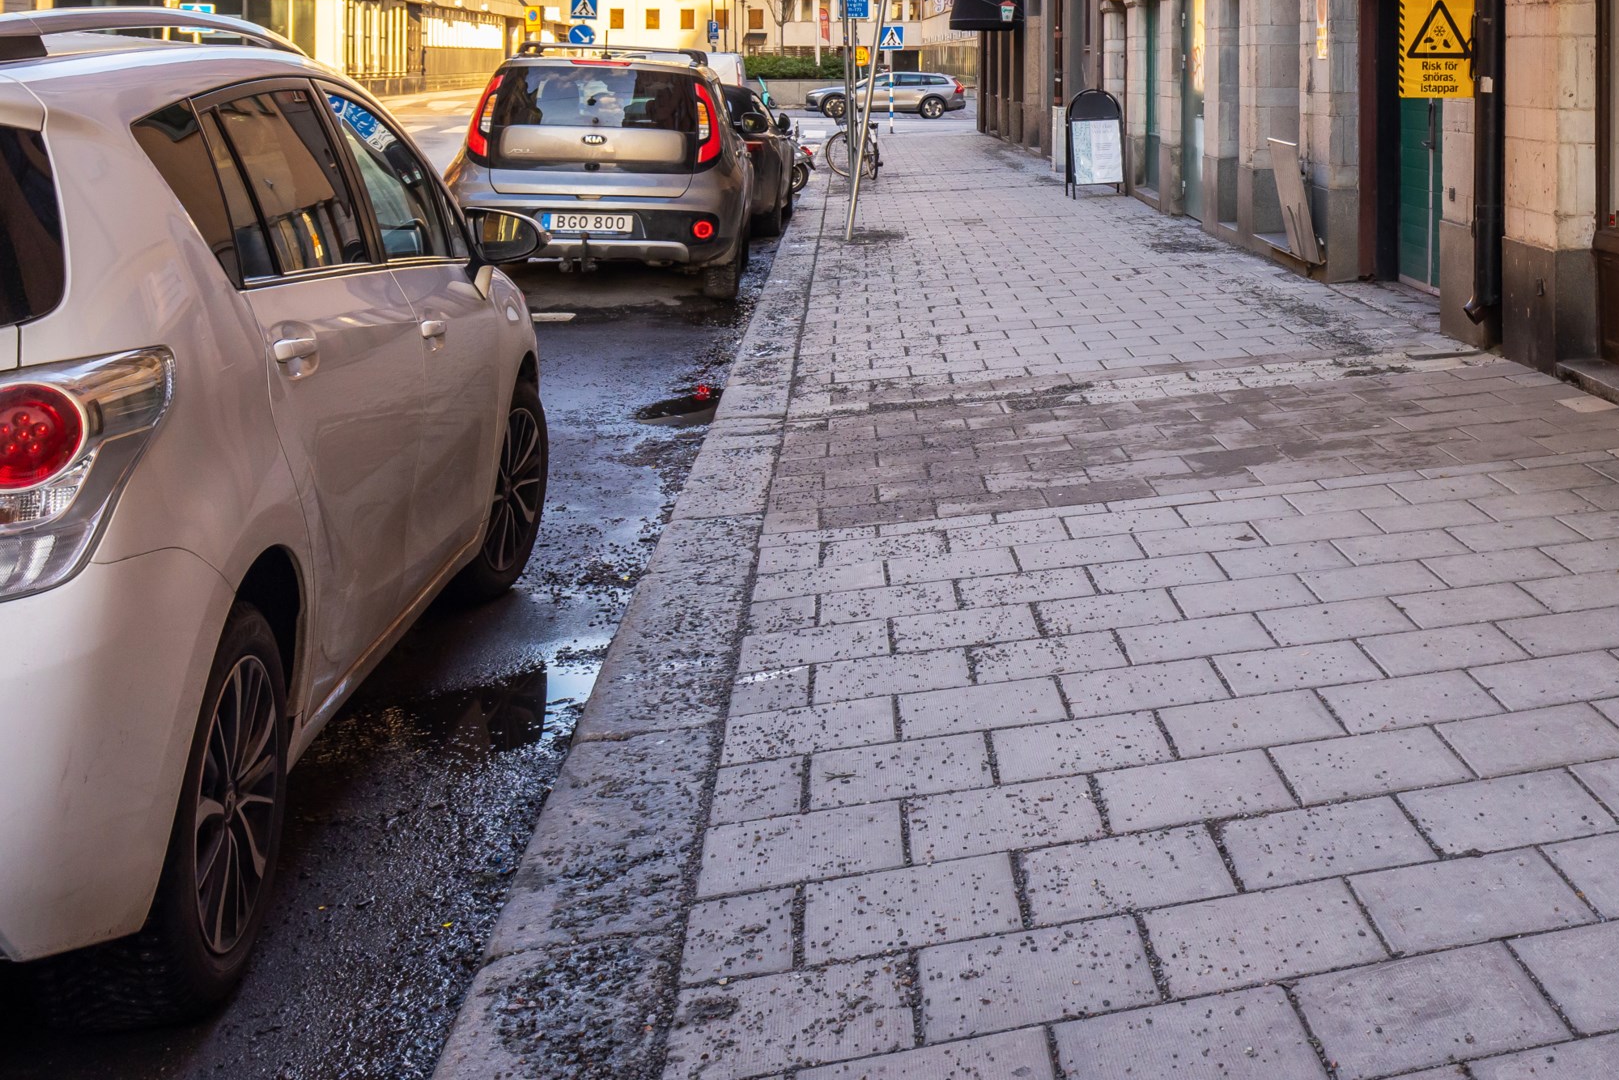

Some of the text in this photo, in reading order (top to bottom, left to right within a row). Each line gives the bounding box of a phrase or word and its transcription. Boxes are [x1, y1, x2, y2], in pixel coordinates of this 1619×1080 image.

[1421, 61, 1459, 71] Risk för
[1422, 72, 1457, 82] snöras,
[1420, 83, 1459, 94] istappar
[584, 135, 603, 143] KIA
[556, 215, 626, 230] BGO 800
